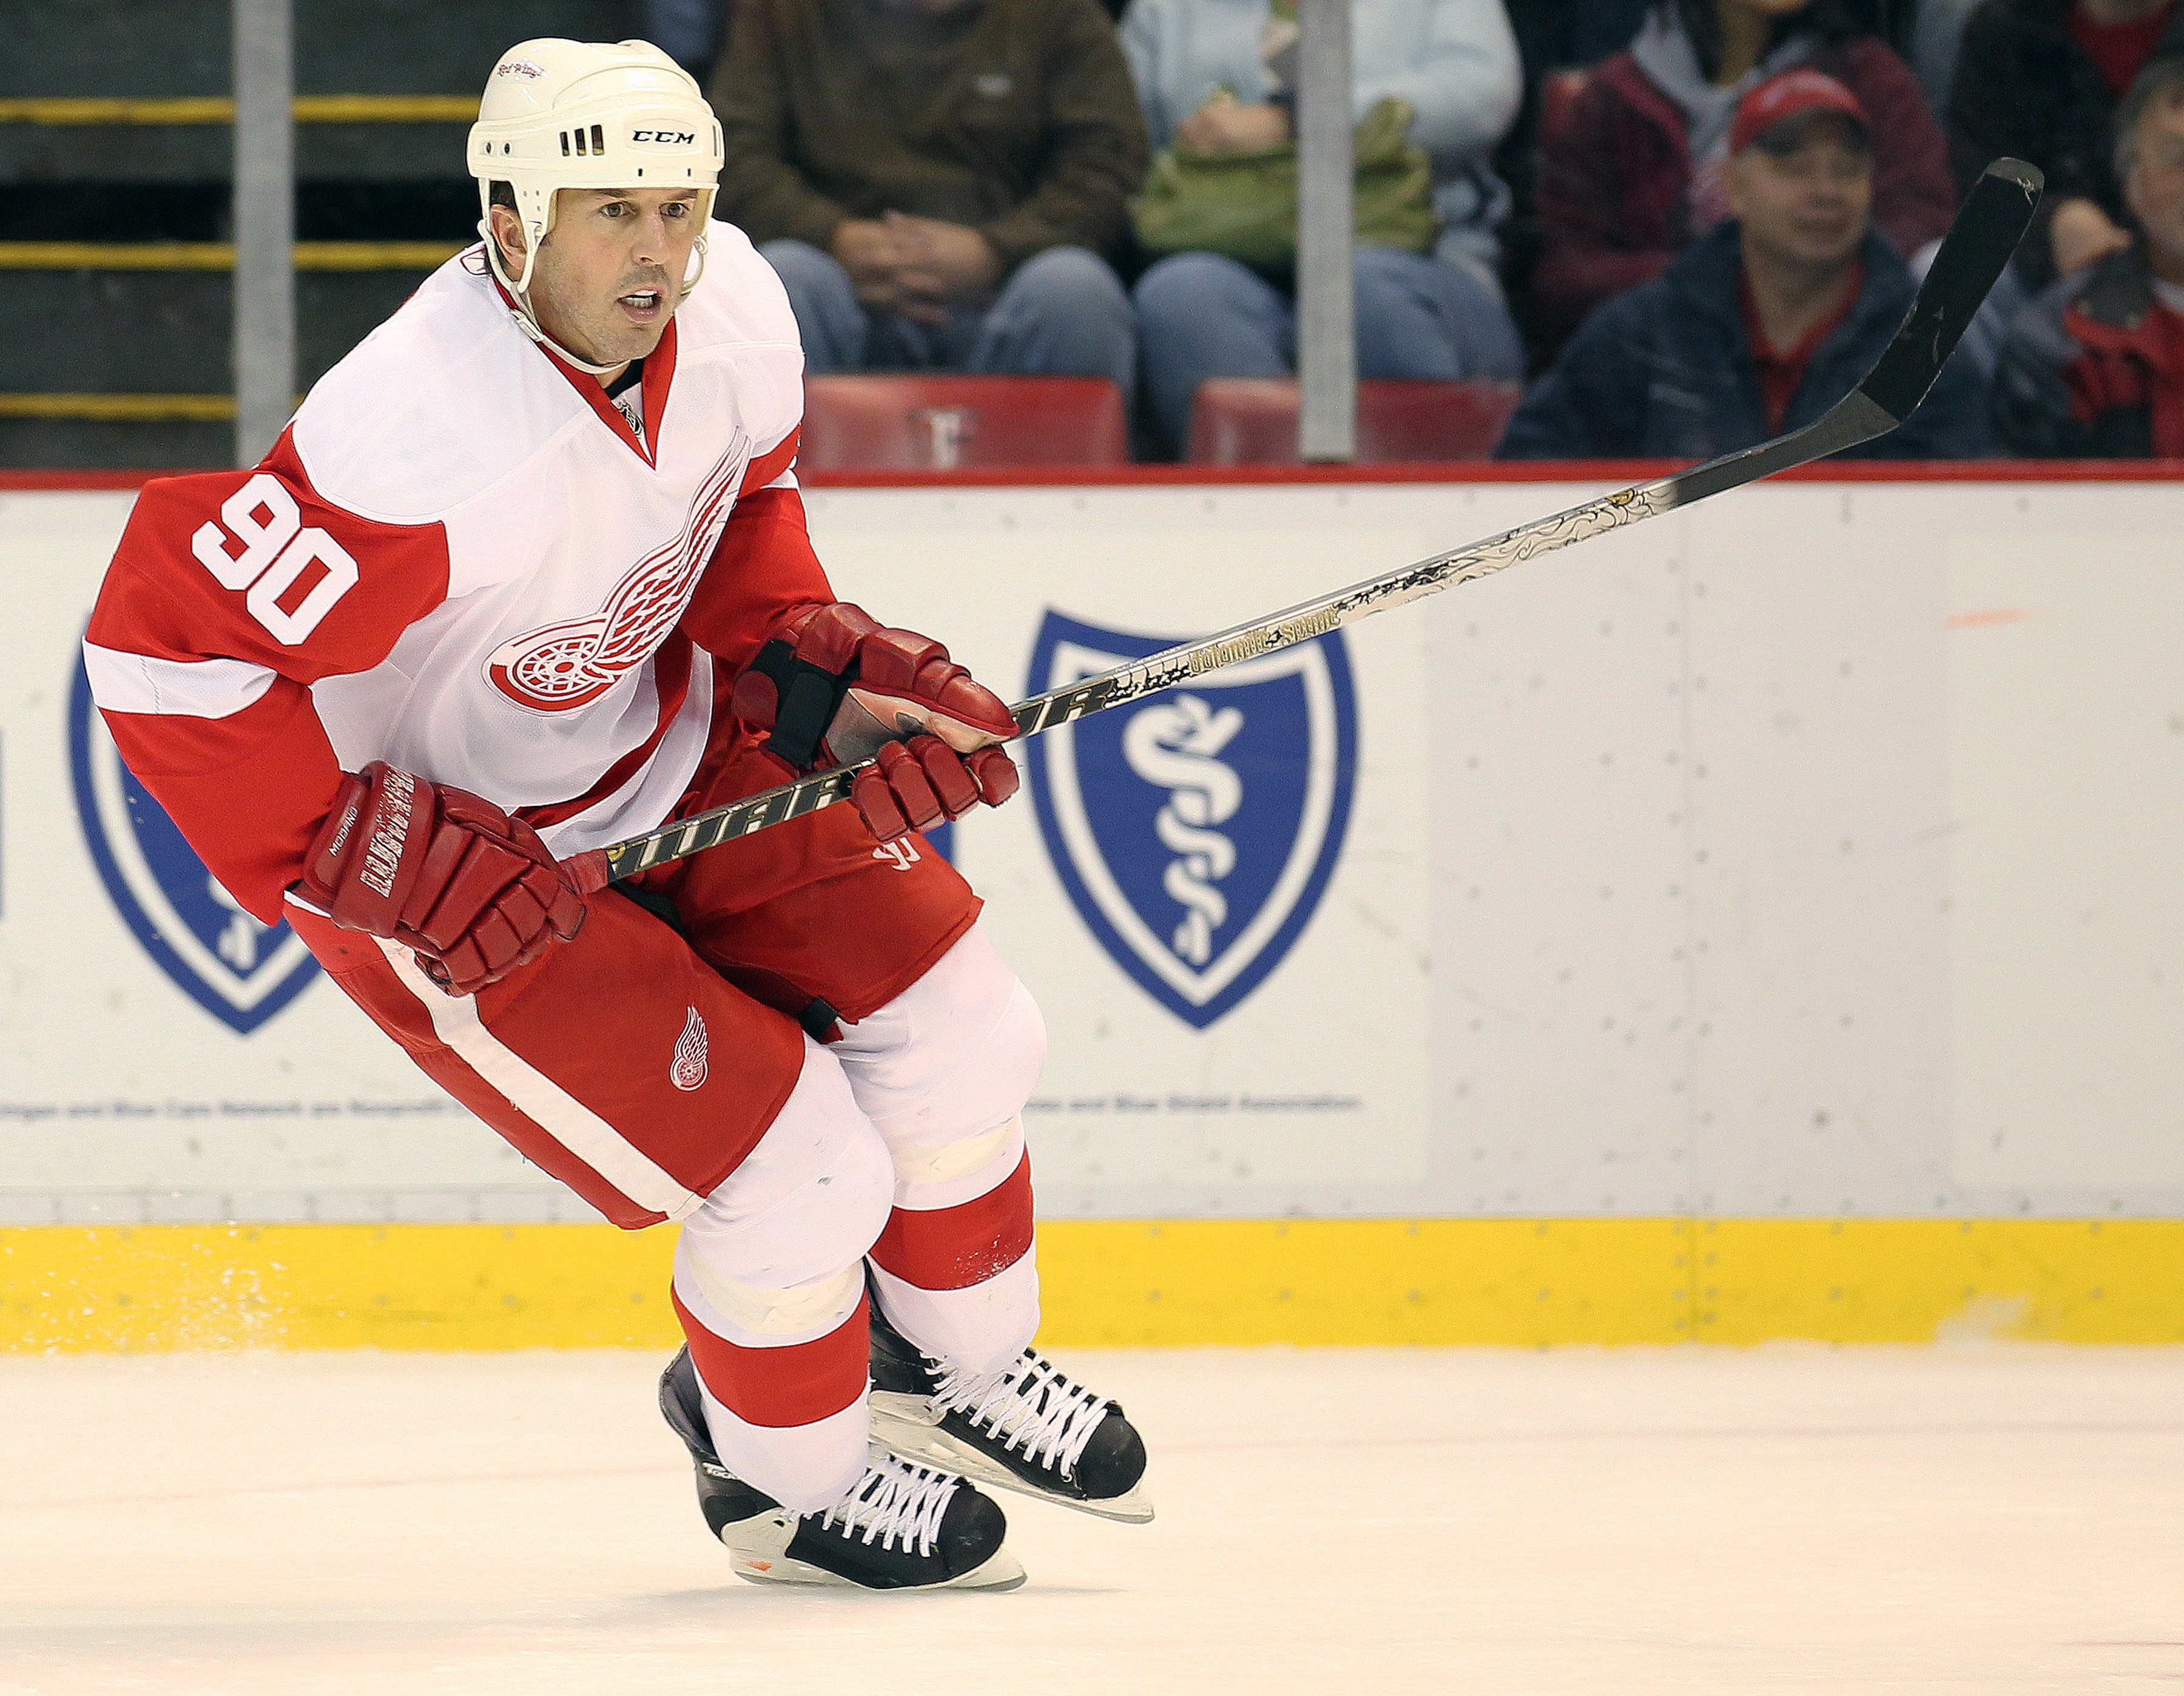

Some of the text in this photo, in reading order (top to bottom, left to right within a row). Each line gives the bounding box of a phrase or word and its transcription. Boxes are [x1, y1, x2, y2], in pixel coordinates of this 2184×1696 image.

[632, 129, 695, 144] CCM
[190, 472, 360, 646] 90
[328, 805, 359, 857] MODANO
